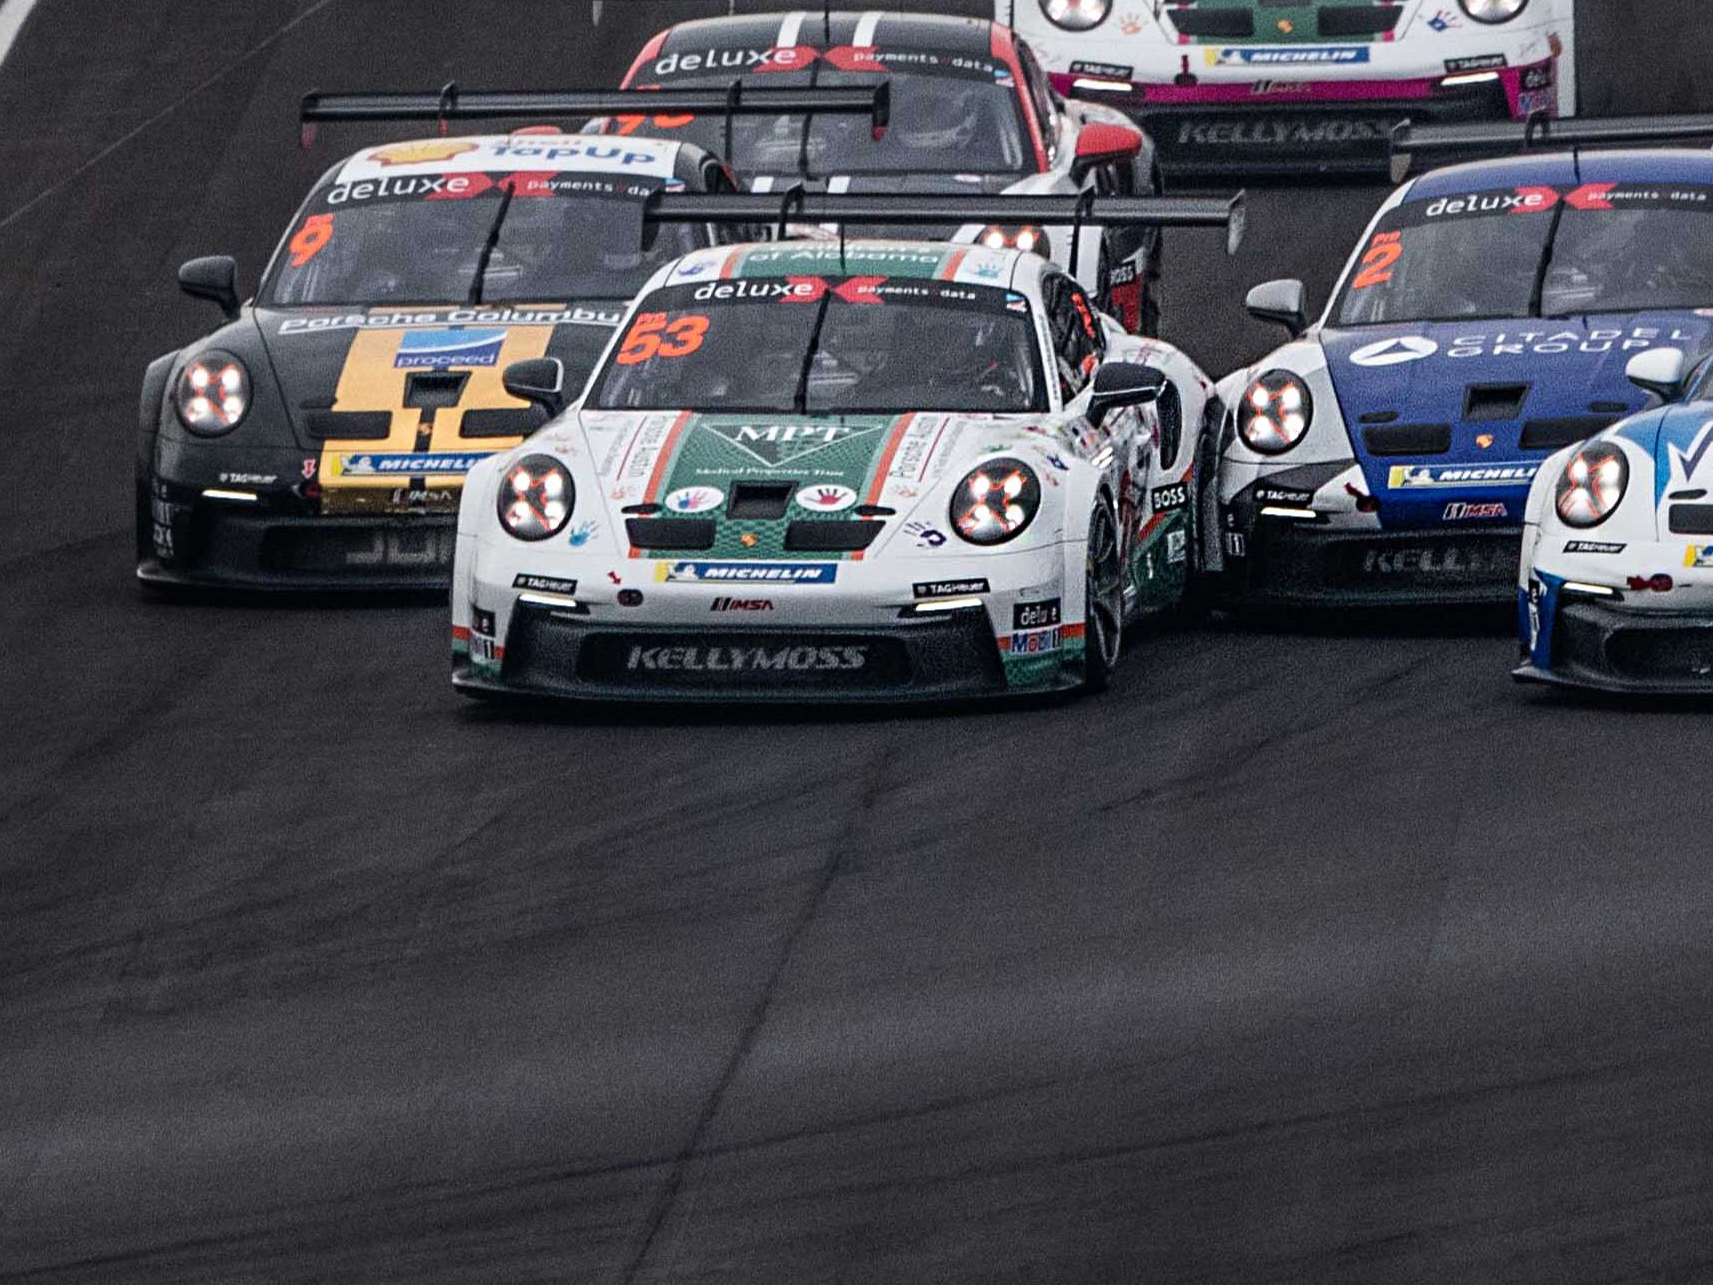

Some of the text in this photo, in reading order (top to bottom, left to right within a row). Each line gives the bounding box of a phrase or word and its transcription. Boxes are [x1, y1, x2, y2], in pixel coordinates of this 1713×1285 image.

[655, 46, 994, 75] deluxe payments data
[1249, 48, 1359, 63] MICHELIN
[327, 175, 650, 204] deluxe payments da
[1425, 189, 1708, 218] deluxe payments data
[290, 223, 333, 268] 9
[749, 250, 940, 264] of Alabama
[1352, 242, 1403, 288] 2
[694, 280, 976, 302] deluxe payments data
[280, 309, 623, 333] Porsche Columbu
[616, 314, 710, 366] 53
[1453, 327, 1691, 348] CITADEL
[1447, 338, 1651, 359] GROUP
[396, 353, 497, 369] proceed
[735, 426, 852, 443] MPT
[378, 458, 474, 470] MICHELI
[1438, 467, 1537, 481] MICHELI
[1154, 487, 1186, 511] BOSS
[1464, 503, 1507, 517] IMSA
[704, 566, 823, 580] MICHELIN
[730, 598, 775, 611] IMSA
[1020, 605, 1060, 626] delue
[625, 644, 869, 672] KELLYMOSS
